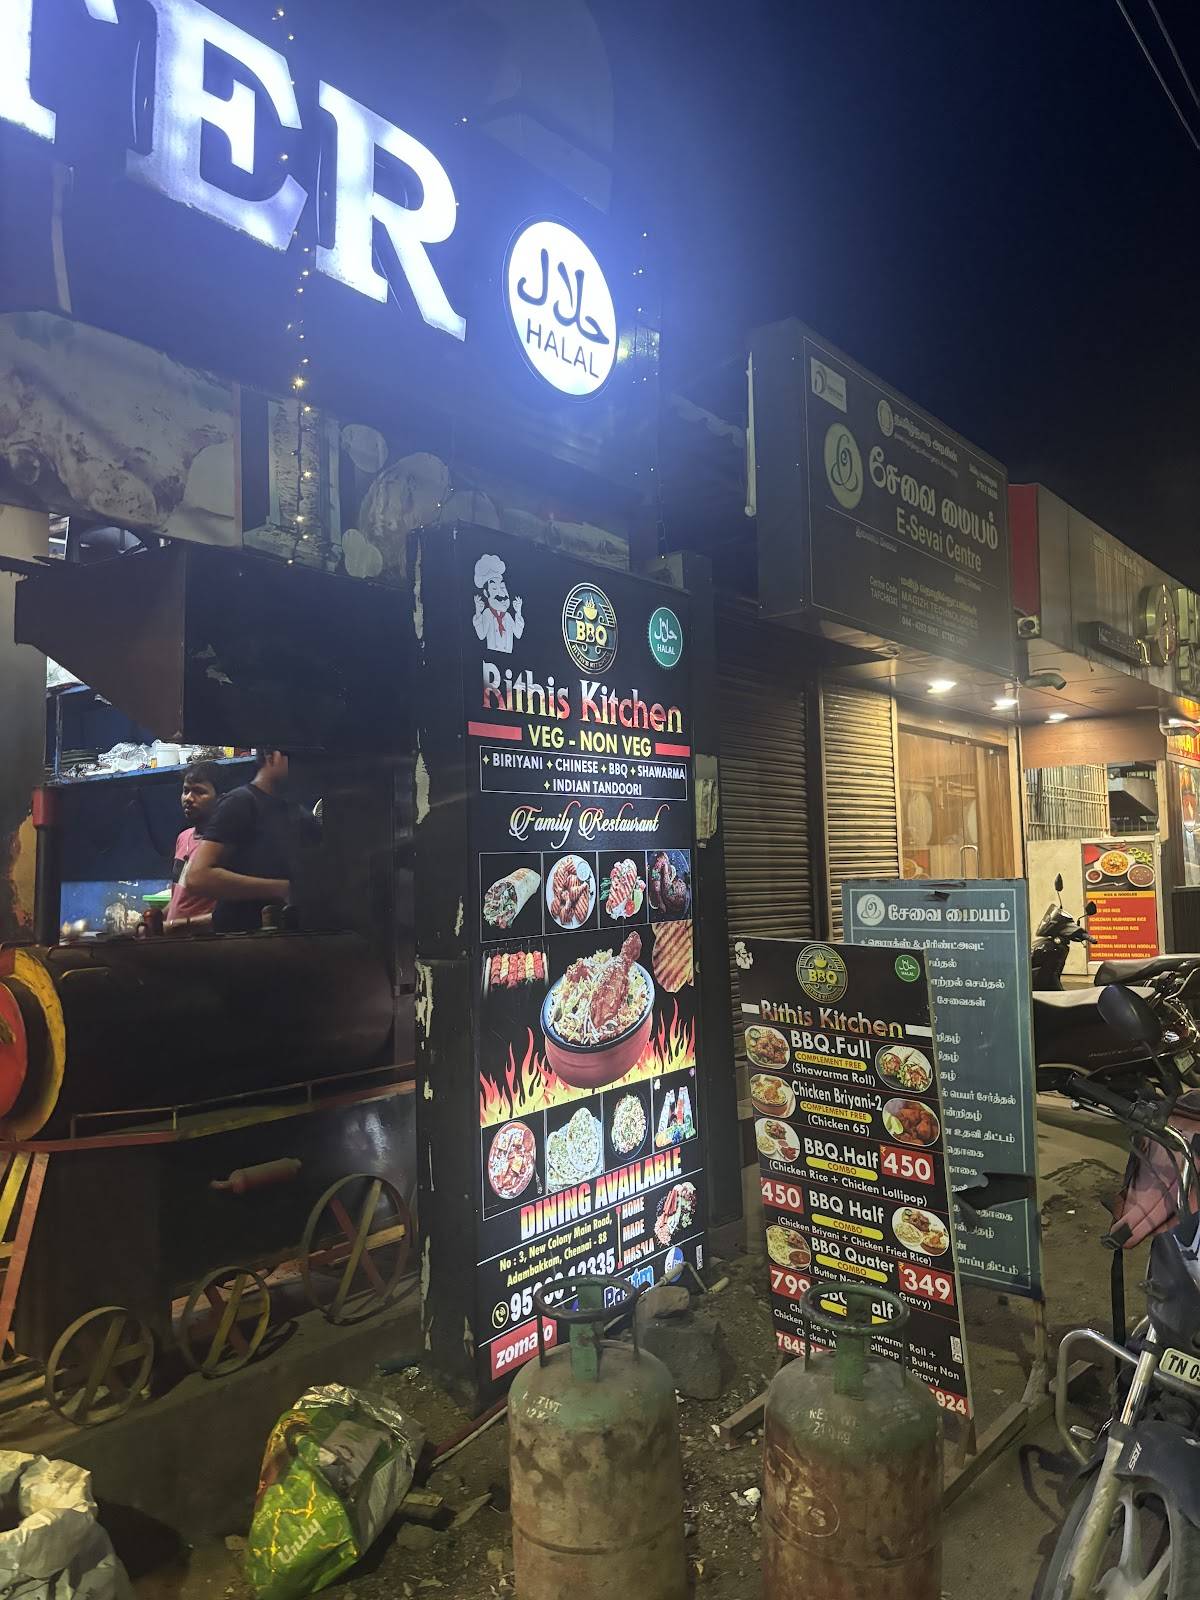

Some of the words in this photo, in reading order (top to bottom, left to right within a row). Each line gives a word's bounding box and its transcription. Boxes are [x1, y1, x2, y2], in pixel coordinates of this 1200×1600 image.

[517, 247, 610, 346] حلال
[526, 317, 601, 380] HALAL
[945, 534, 981, 572] Centre
[575, 619, 608, 647] BBQ
[656, 643, 676, 655] HALAL
[482, 660, 571, 721] Rithis
[580, 680, 684, 734] Kitchen
[528, 724, 565, 748] VEG
[580, 731, 618, 754] NON
[622, 735, 652, 757] VEG
[492, 753, 544, 770] BIRIYANI
[555, 759, 599, 774] CHINESE
[608, 763, 628, 778] BBQ
[637, 766, 686, 780] SHAWARMA
[553, 779, 591, 794] INDIAN
[593, 781, 642, 796] TANDOORI
[509, 801, 581, 849] Family
[580, 802, 670, 842] Restaurant
[888, 904, 942, 922] சேவை
[945, 902, 1011, 922] மையம்
[807, 969, 838, 985] BBQ
[760, 1000, 814, 1026] Rithis
[818, 1007, 904, 1039] Kitchen
[792, 1062, 849, 1081] (Shawarma
[850, 1073, 876, 1087] Roll)
[796, 1052, 843, 1067] COMPLEMENT
[844, 1060, 862, 1070] FREE
[791, 1080, 832, 1101] Chicken
[833, 1089, 883, 1112] Briyani-2
[802, 1102, 849, 1118] COMPLEMENT
[850, 1110, 867, 1120] FREE
[807, 1114, 850, 1134] (Chicken
[852, 1122, 870, 1137] 65)
[827, 1160, 857, 1176] COMBO
[521, 1183, 592, 1241] DINING
[594, 1147, 682, 1209] AVAILABLE
[769, 1160, 807, 1179] (Chicken
[809, 1170, 829, 1183] Rice
[831, 1174, 839, 1184] +
[841, 1178, 880, 1196] Chicken
[881, 1186, 928, 1207] Lollipop)
[621, 1197, 645, 1220] HOME
[808, 1190, 844, 1213] BBQ
[848, 1199, 886, 1224] Half
[622, 1219, 645, 1242] MADE
[777, 1216, 810, 1233] (Chicken
[811, 1224, 840, 1241] Briyani
[842, 1234, 849, 1242] +
[850, 1236, 884, 1252] Chicken
[885, 1244, 908, 1260] Fried
[909, 1252, 932, 1267] Rice)
[833, 1221, 863, 1235] COMBO
[499, 1259, 512, 1272] No
[518, 1248, 528, 1262] 3,
[528, 1246, 546, 1260] New
[547, 1231, 572, 1251] Colony
[573, 1224, 592, 1238] Main
[593, 1213, 613, 1231] Road,
[623, 1238, 655, 1266] MASALA
[811, 1236, 841, 1256] BBQ
[844, 1246, 895, 1273] Quater
[506, 1256, 562, 1288] Adambakkam,
[563, 1239, 592, 1260] Chennai
[837, 1261, 867, 1276] COMBO
[813, 1267, 838, 1282] Butter
[898, 1291, 932, 1312] Gravy)
[871, 1299, 895, 1319] alf
[796, 1327, 827, 1346] Chcken
[810, 1320, 822, 1331] ice
[494, 1324, 554, 1369] zomao
[909, 1343, 927, 1357] Roll
[928, 1350, 937, 1359] +
[870, 1343, 900, 1360] ollipop
[911, 1356, 938, 1373] Butter
[939, 1366, 960, 1381] Non
[1168, 1353, 1189, 1376] TN
[911, 1367, 940, 1387] Gravy
